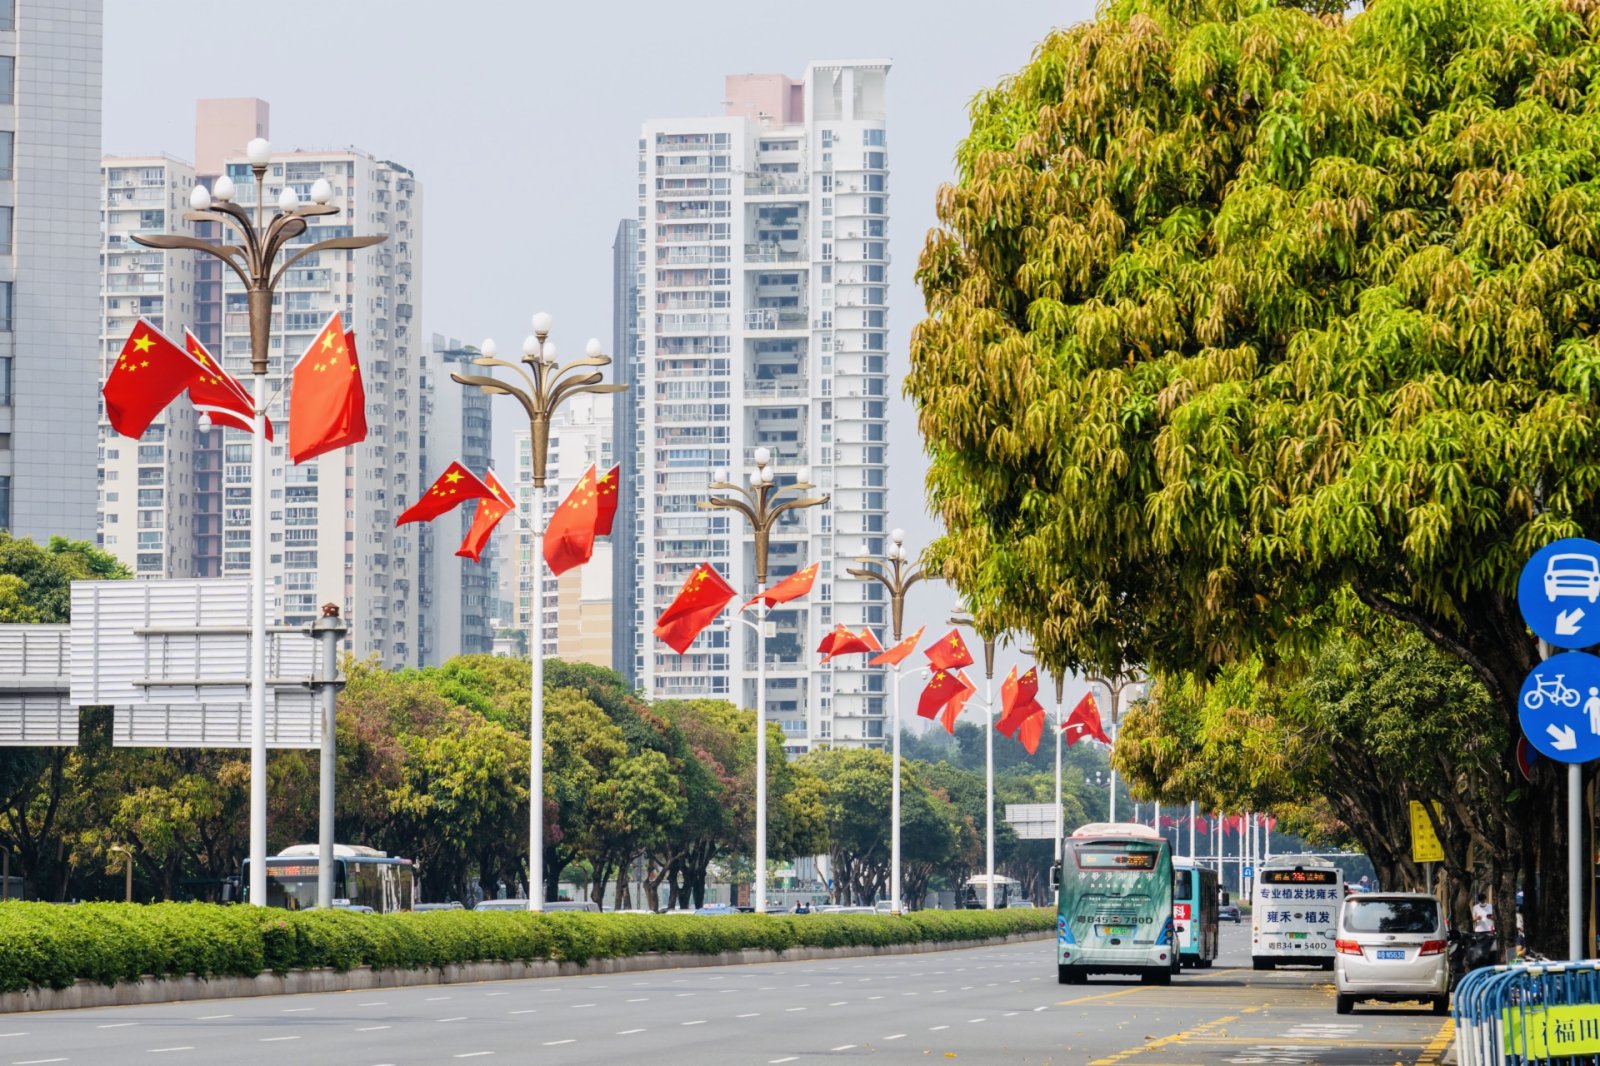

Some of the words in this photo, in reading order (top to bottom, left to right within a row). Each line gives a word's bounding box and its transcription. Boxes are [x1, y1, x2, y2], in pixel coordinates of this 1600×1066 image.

[1260, 888, 1338, 900] 专业植发找雍禾
[1267, 911, 1292, 923] 雍禾
[1304, 911, 1330, 923] 植发
[1555, 1018, 1599, 1043] 福田
